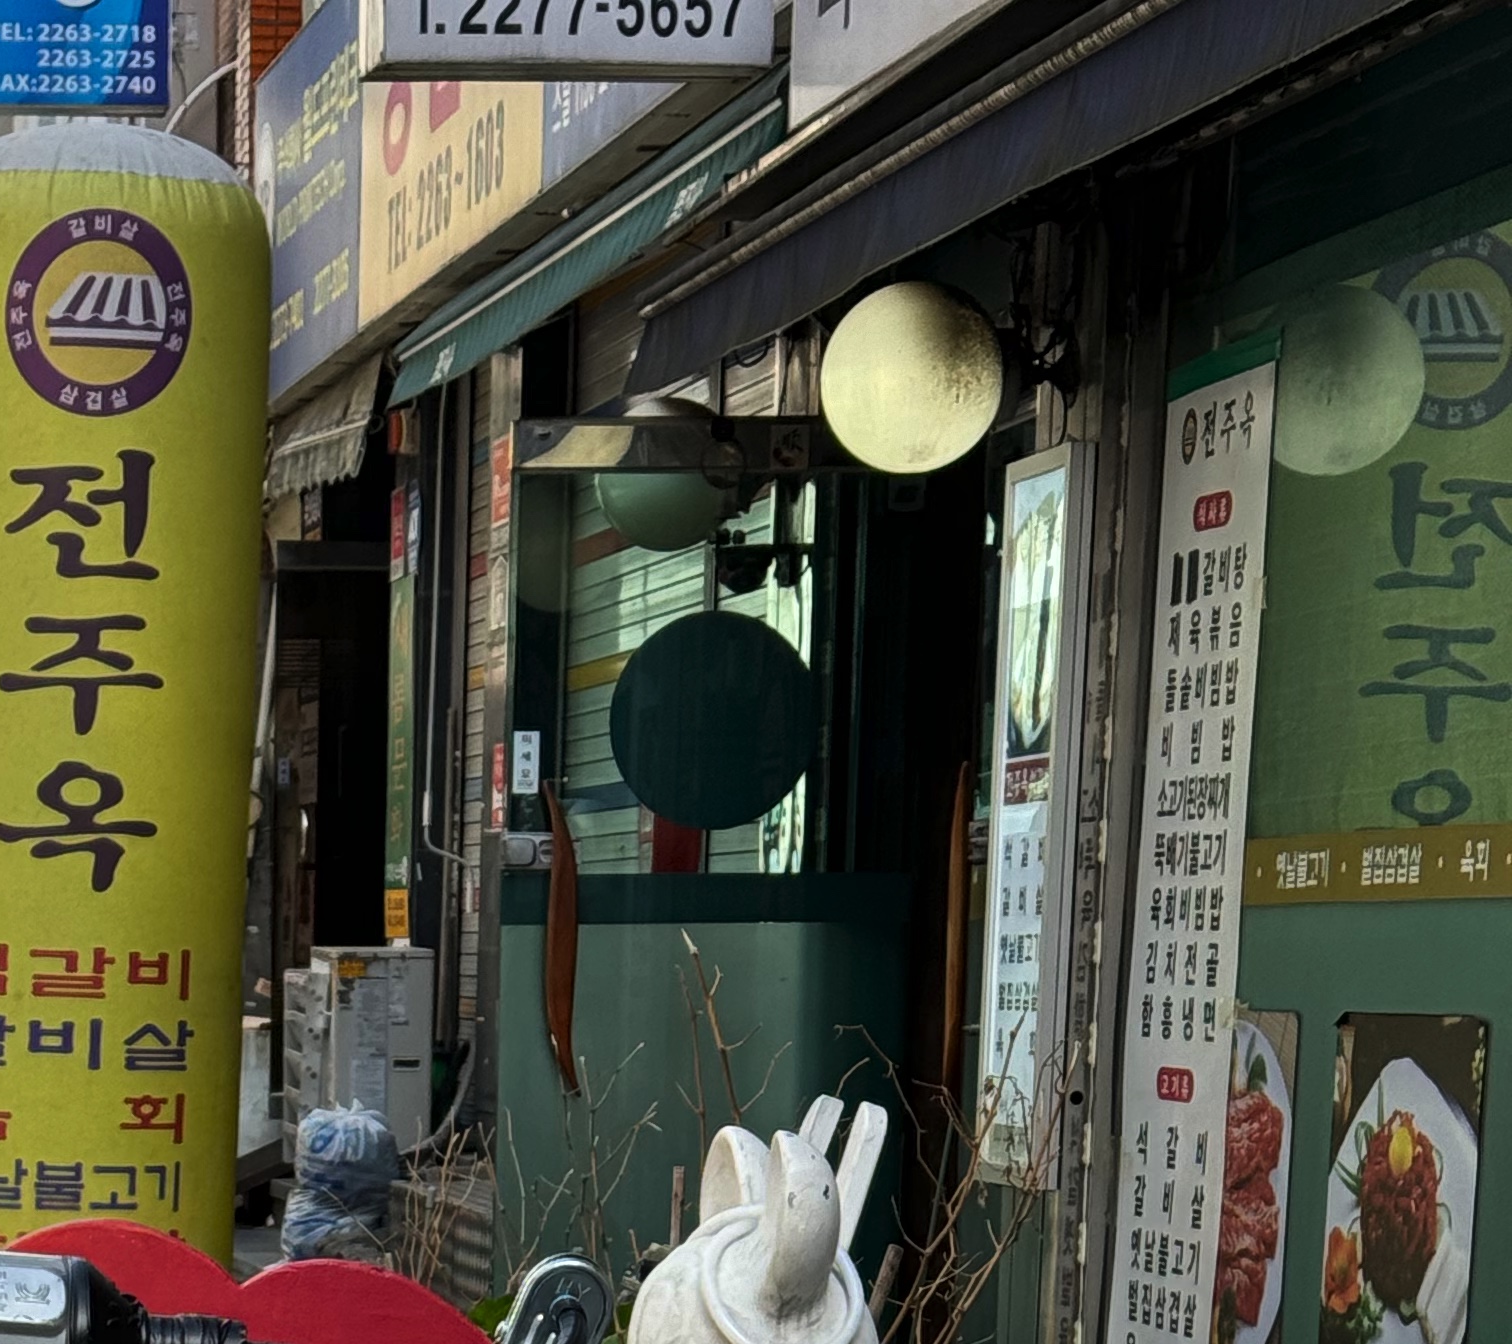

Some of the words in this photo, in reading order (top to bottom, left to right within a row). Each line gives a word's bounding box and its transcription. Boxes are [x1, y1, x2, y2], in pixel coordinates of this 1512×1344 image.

[36, 23, 157, 43] 2263-2718
[36, 49, 157, 69] 2263-2725
[67, 213, 139, 241] 갈비살
[58, 383, 129, 411] 삼겹살
[1200, 390, 1256, 461] 전주옥
[1161, 715, 1236, 767] 비빔밥
[1150, 885, 1223, 931] 육회비빔밥
[1146, 940, 1219, 988] 김치전골
[1136, 1120, 1208, 1176] 석갈비
[1133, 1174, 1205, 1230] 갈비살
[1131, 1227, 1201, 1285] 옛날불고기
